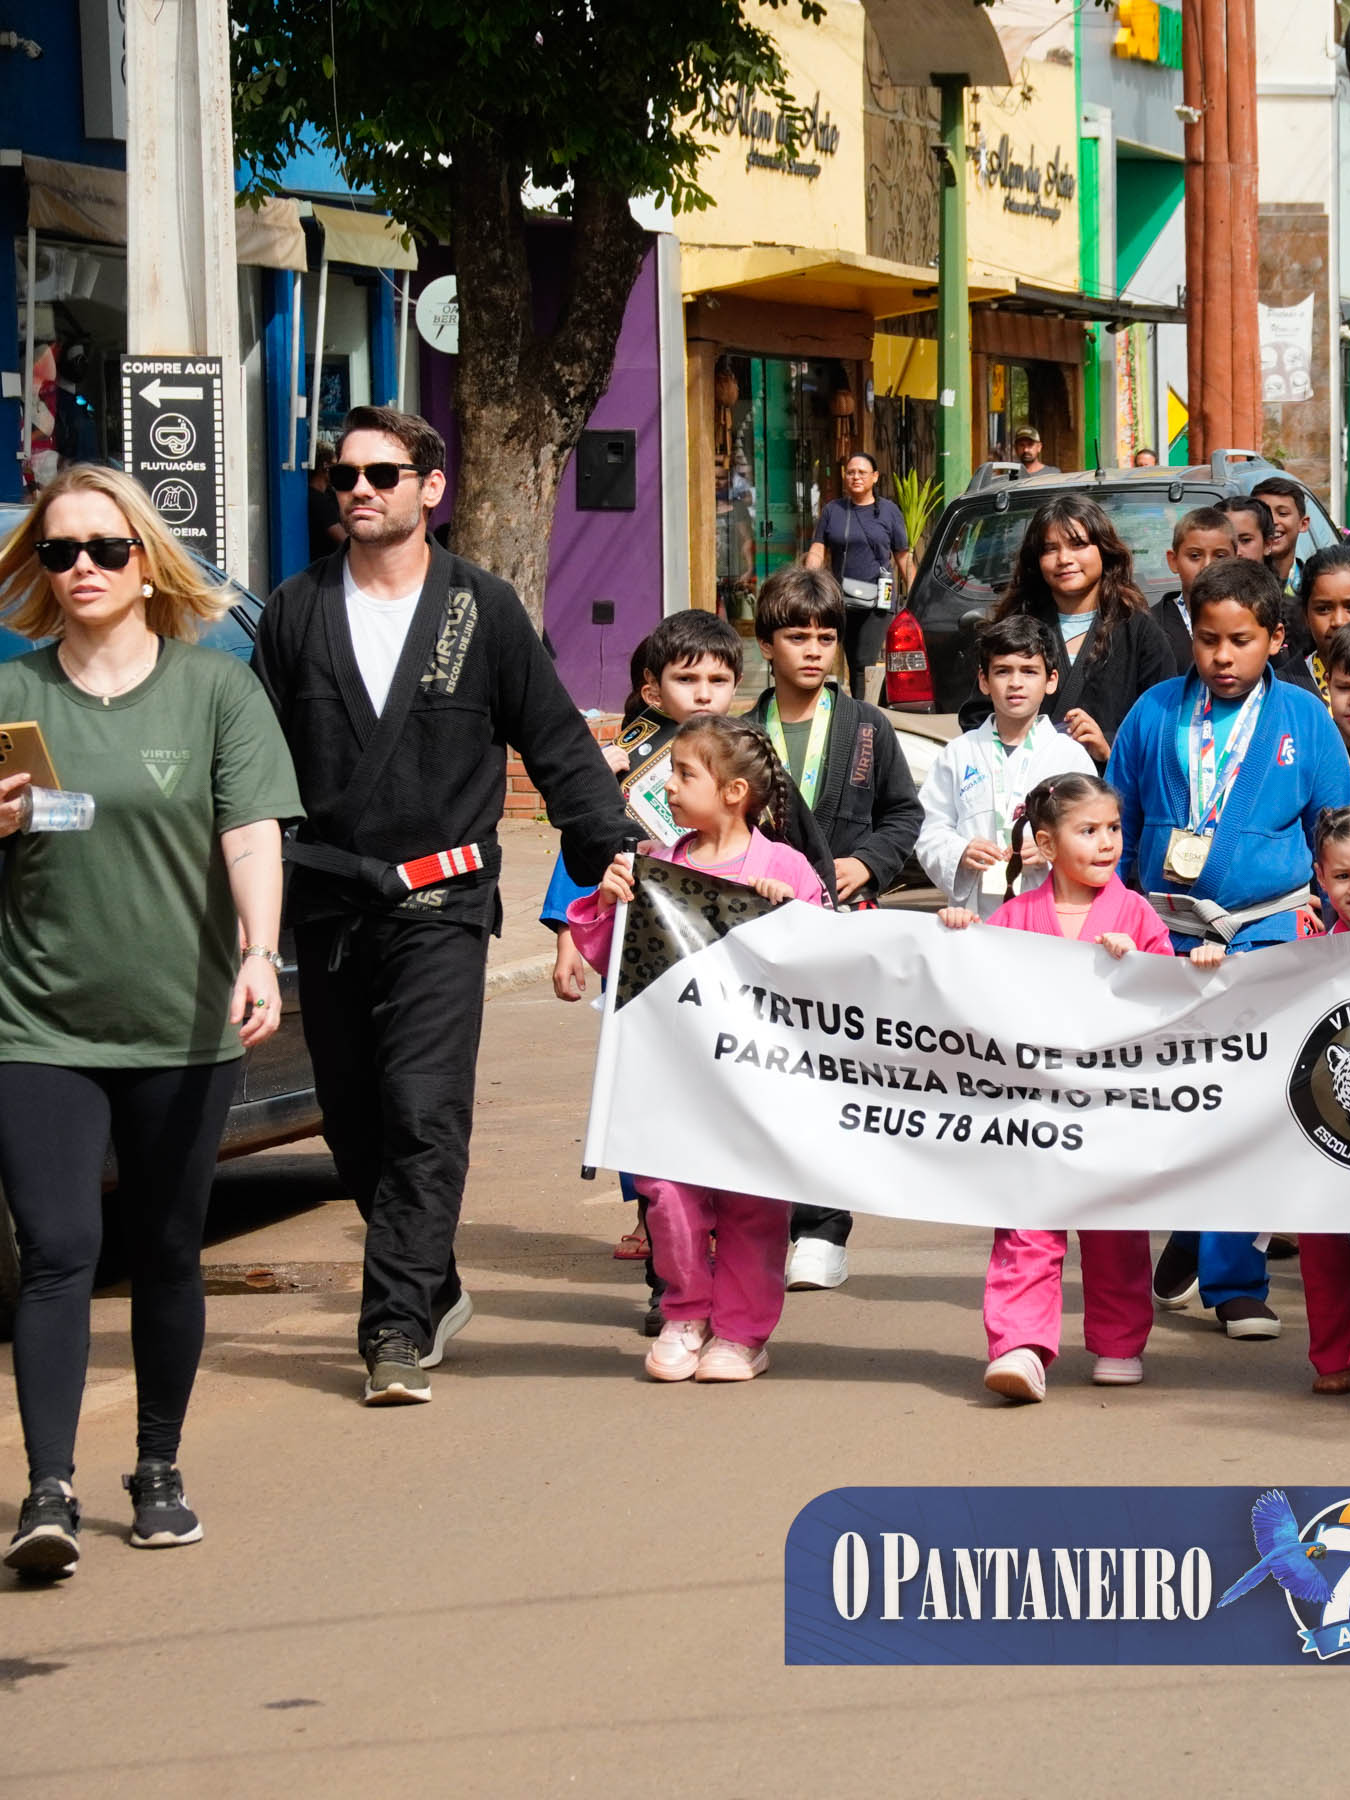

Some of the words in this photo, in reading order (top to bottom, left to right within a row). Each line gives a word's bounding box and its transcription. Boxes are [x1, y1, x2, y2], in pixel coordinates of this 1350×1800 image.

[122, 362, 182, 374] COMPRE
[184, 363, 220, 375] AQUI
[140, 461, 206, 472] FLUTUAÇÕES
[420, 592, 472, 682] VIRTUS
[445, 652, 465, 694] ESCOLA
[458, 635, 472, 651] DE
[140, 749, 191, 759] VIRTUS
[853, 727, 873, 781] VIRTUS
[678, 977, 702, 1007] A
[876, 1017, 1007, 1066] ESCOLA
[1016, 1042, 1064, 1070] DE
[1076, 1046, 1143, 1069] JIU
[1156, 1032, 1268, 1066] JITSU
[714, 1032, 948, 1095] PARABENIZA
[956, 1071, 1092, 1108] BONITO
[1104, 1084, 1223, 1113] PELOS
[839, 1103, 926, 1139] SEUS
[935, 1112, 972, 1142] 78
[980, 1117, 1084, 1151] ANOS
